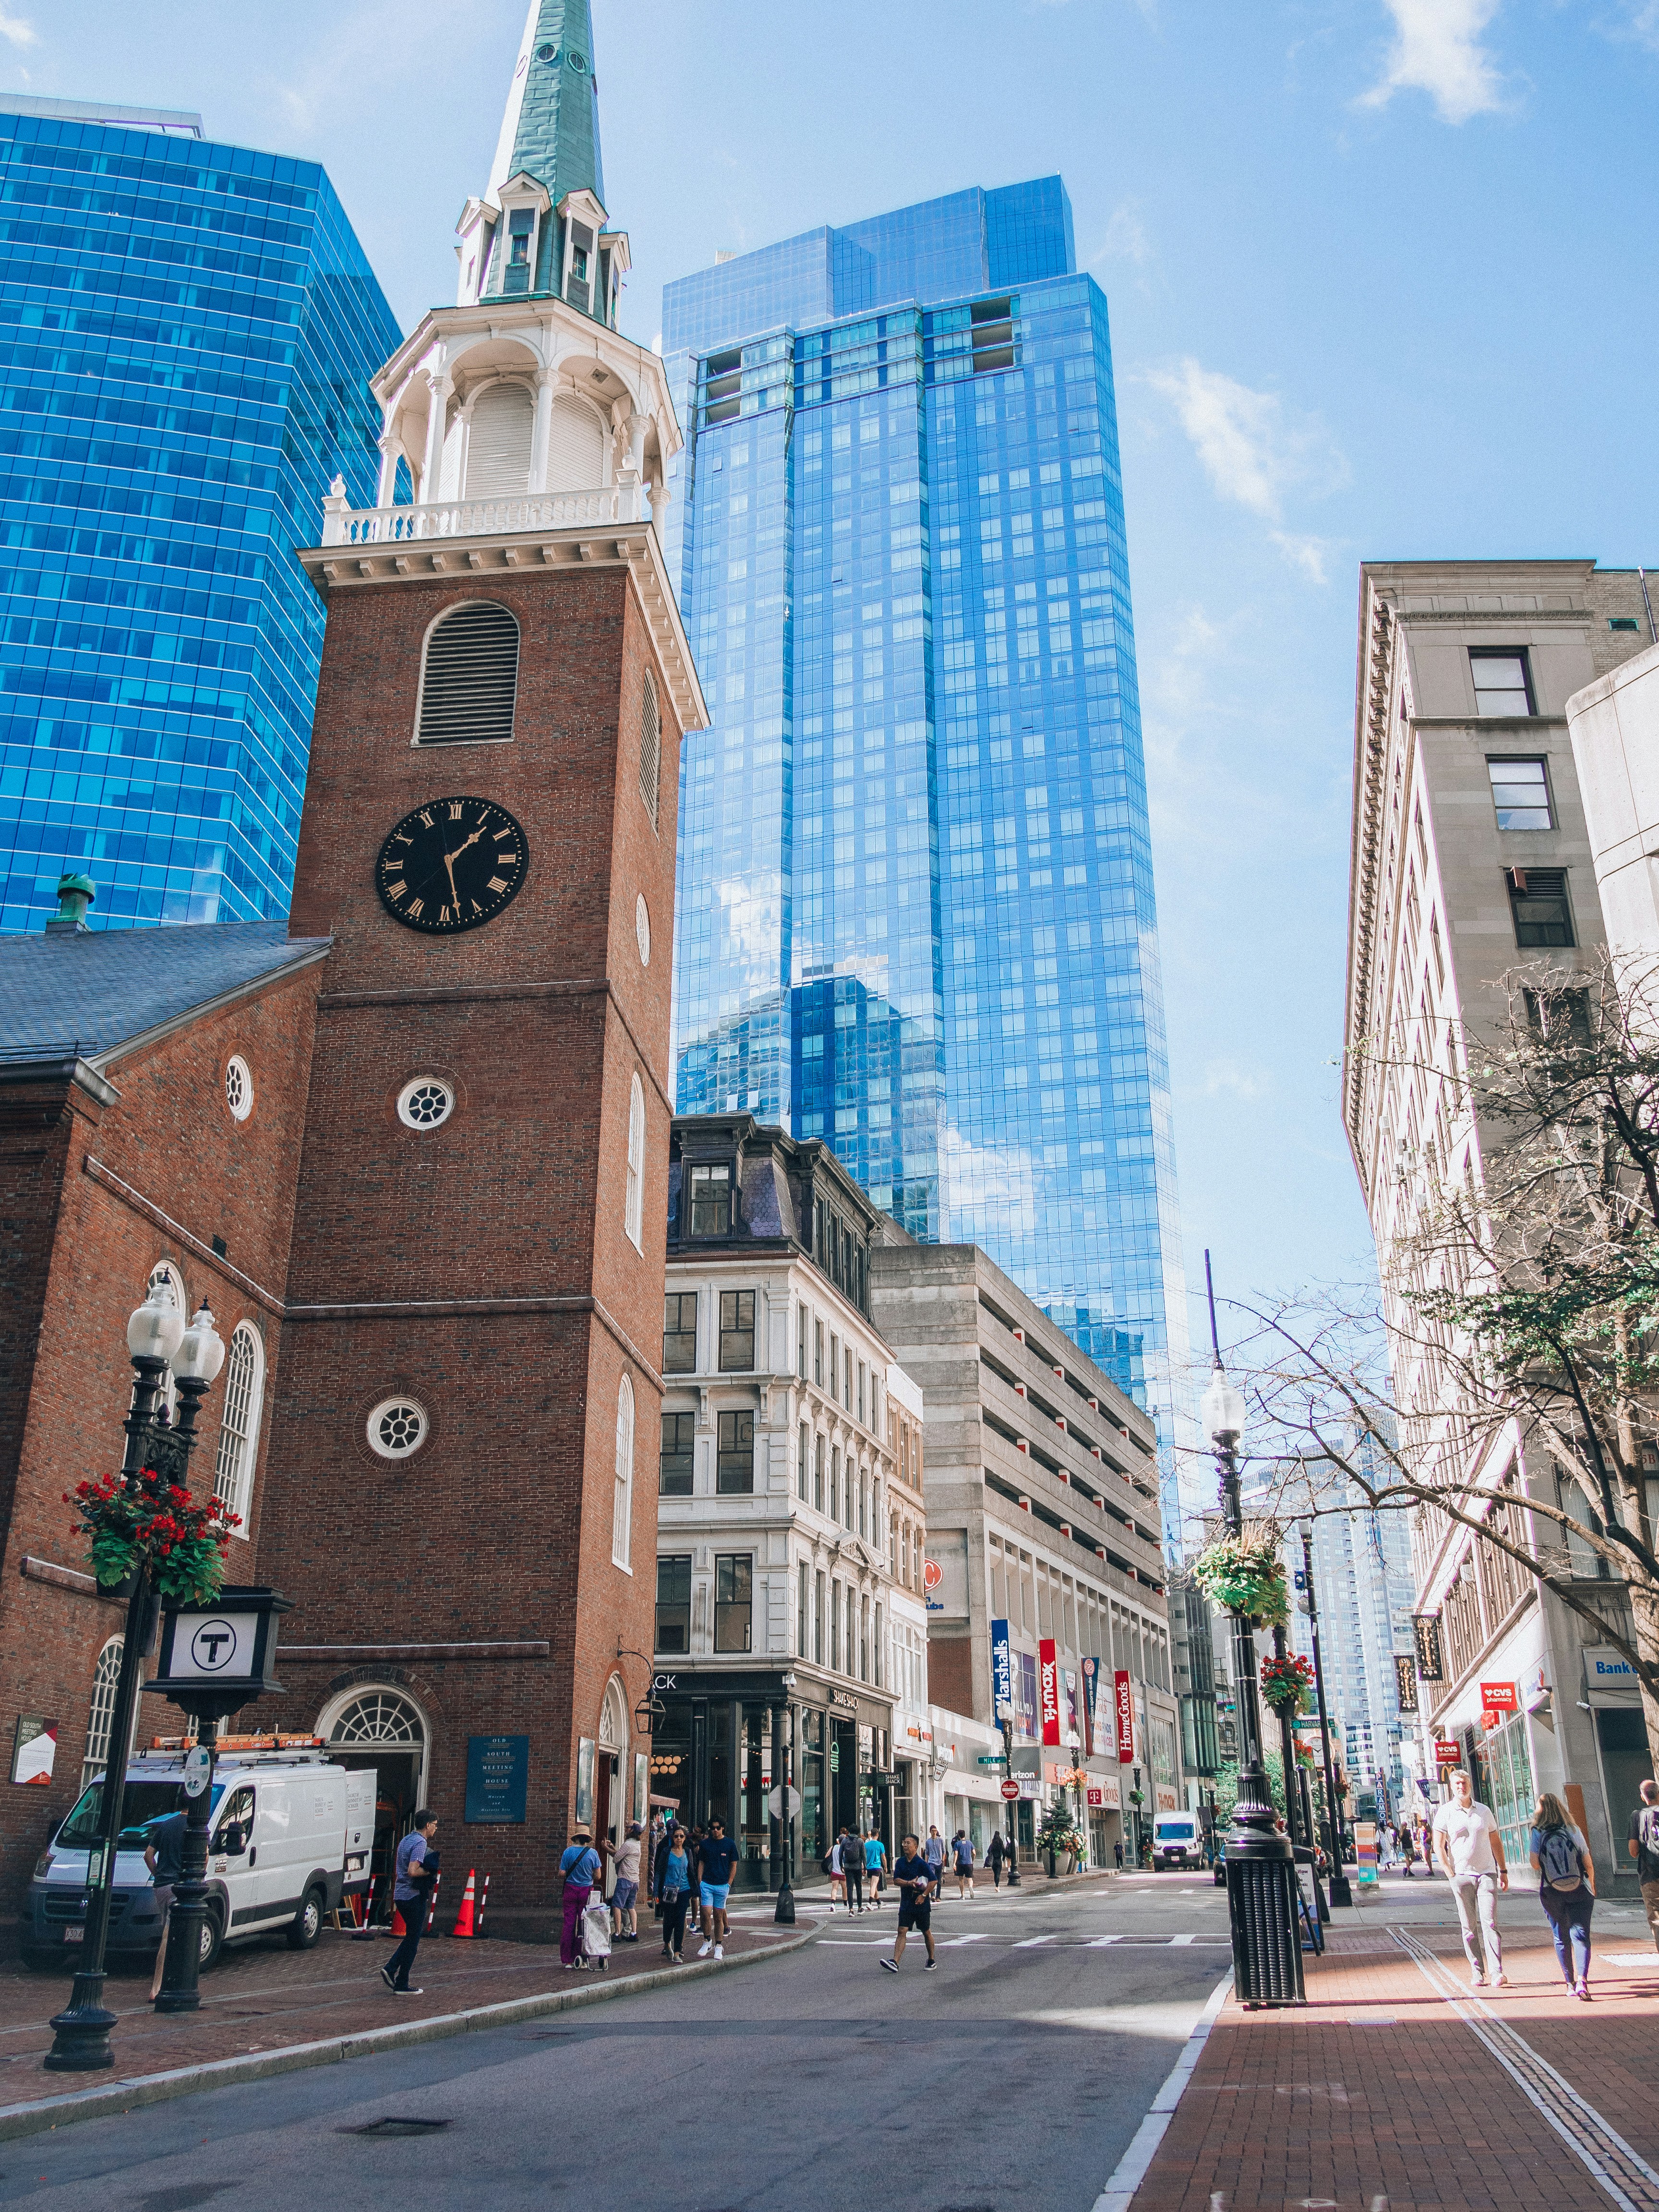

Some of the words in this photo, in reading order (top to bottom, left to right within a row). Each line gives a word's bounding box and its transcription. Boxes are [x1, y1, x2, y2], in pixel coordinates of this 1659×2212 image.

[448, 804, 463, 819] XII
[476, 809, 490, 825] I
[419, 811, 435, 829] XI
[396, 833, 414, 846] X
[493, 828, 511, 842] II
[385, 859, 403, 870] IX
[498, 854, 516, 864] III
[388, 879, 408, 901] VIII
[486, 876, 509, 894] IIII
[407, 897, 424, 917] VII
[439, 905, 451, 921] VI
[471, 899, 483, 914] V
[200, 1634, 230, 1662] T
[1596, 1661, 1630, 1674] Bank
[653, 1675, 676, 1689] CK
[834, 1690, 846, 1705] SHAKE
[846, 1695, 859, 1710] SHACK
[1118, 1682, 1132, 1752] HomeGoods
[1006, 1770, 1035, 1779] erizon
